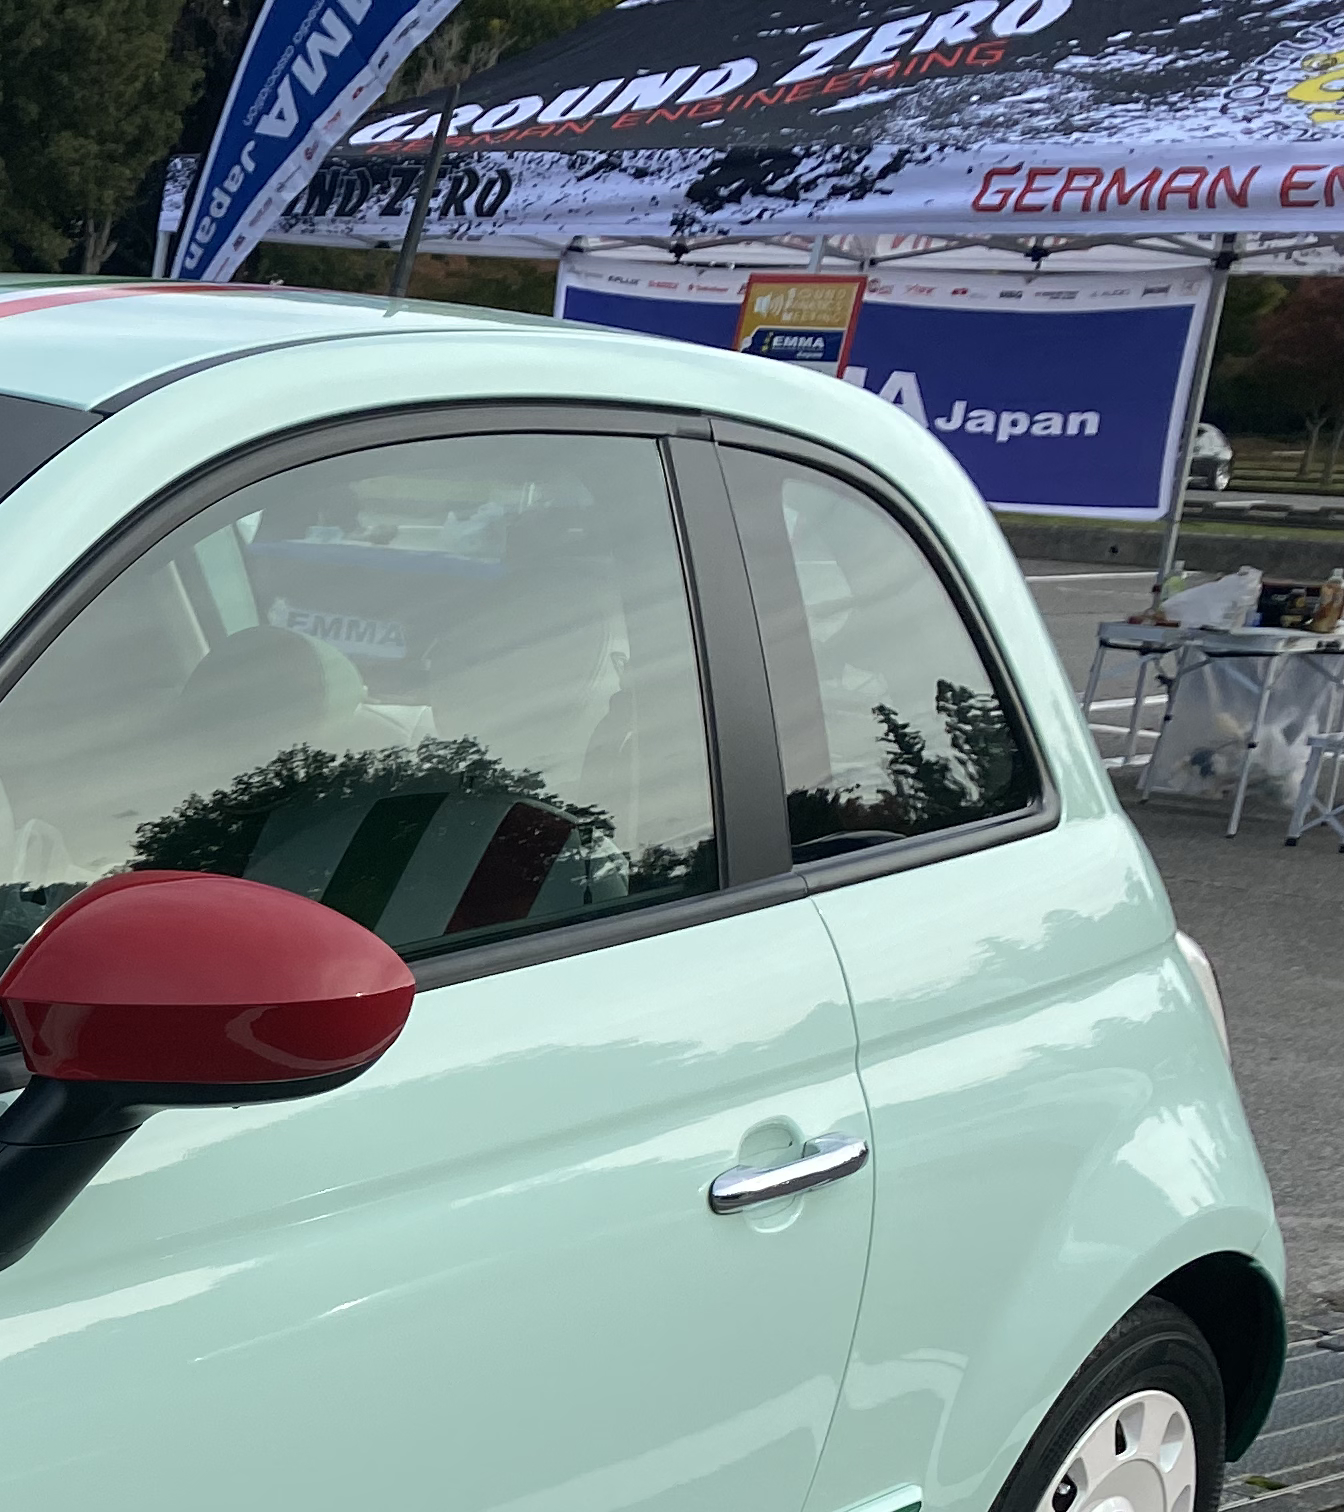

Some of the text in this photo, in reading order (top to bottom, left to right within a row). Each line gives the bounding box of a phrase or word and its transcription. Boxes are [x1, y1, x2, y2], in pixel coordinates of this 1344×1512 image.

[348, 0, 1073, 147] GROUND ZERO
[611, 38, 1012, 131] ENGINEERING
[184, 140, 257, 271] Japan
[971, 160, 1264, 214] GERMAN
[771, 335, 826, 349] EMMA
[934, 400, 1101, 444] Japan
[286, 610, 405, 647] EMMA
